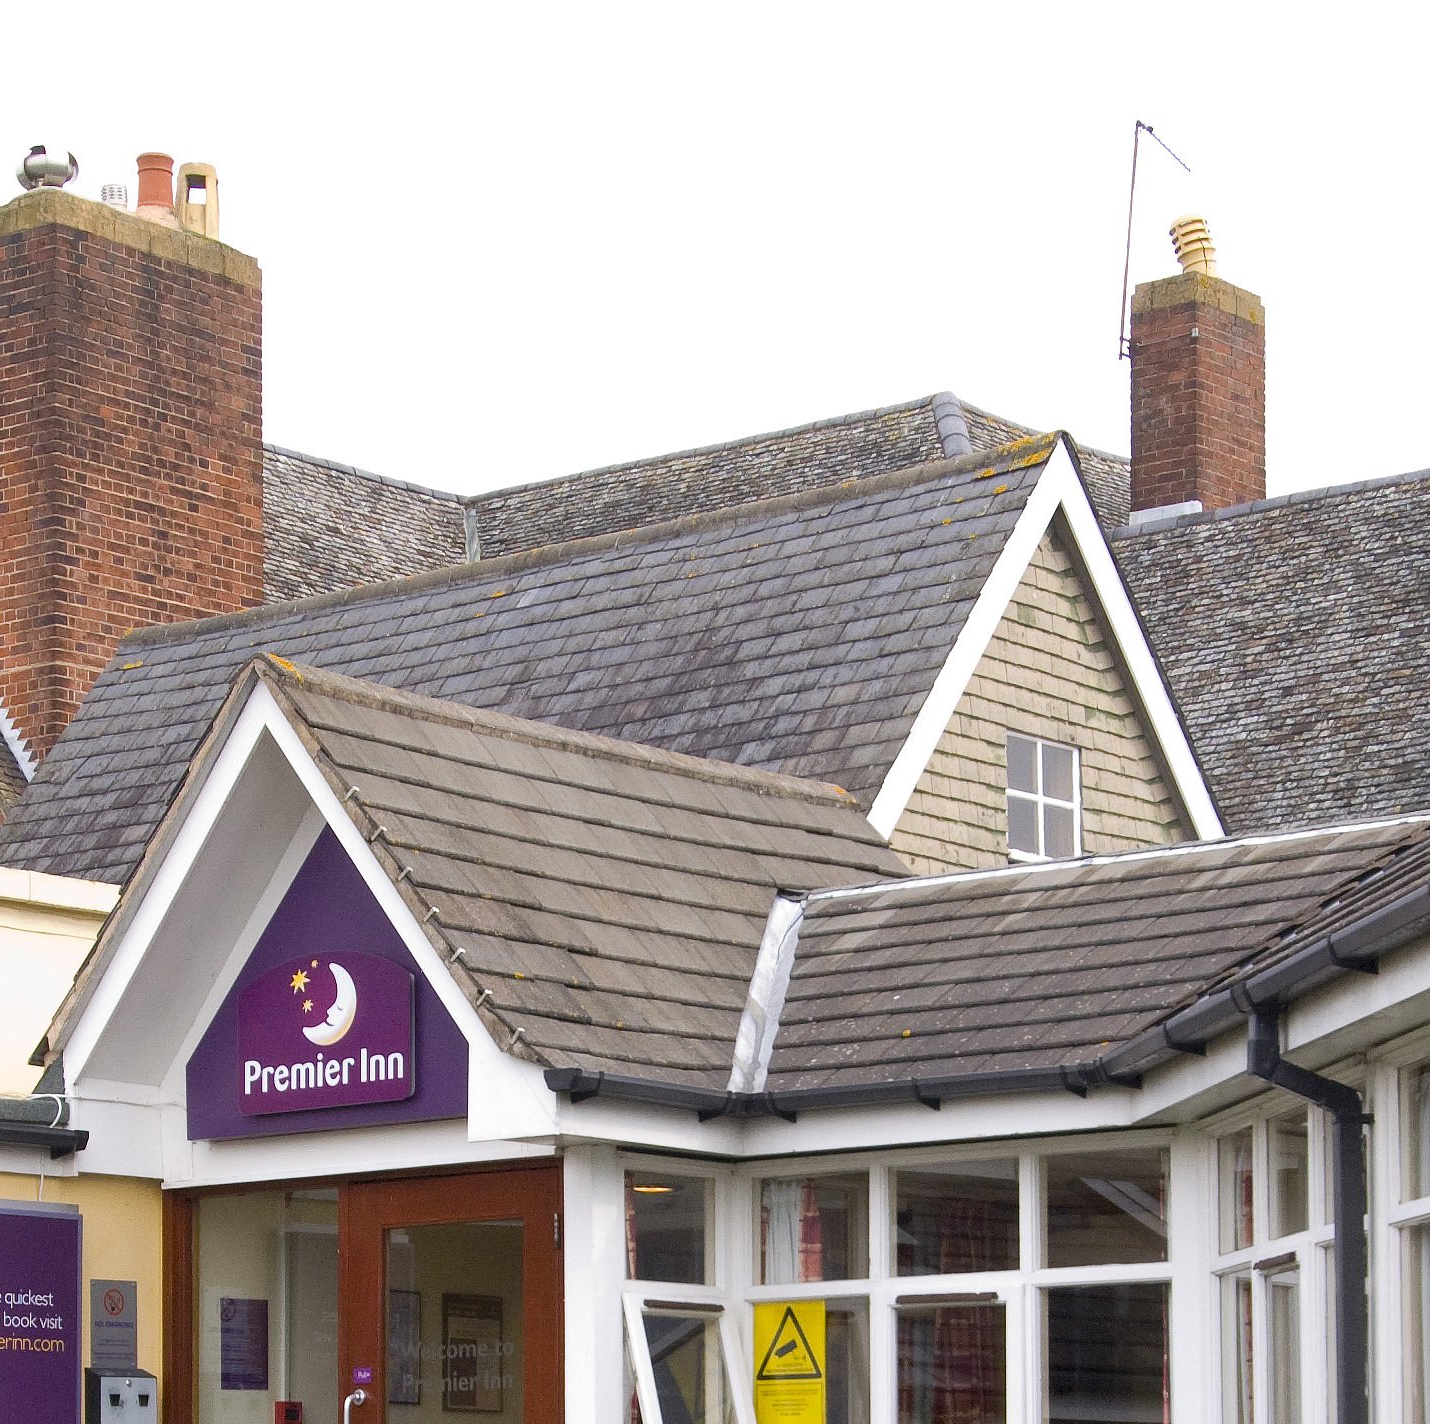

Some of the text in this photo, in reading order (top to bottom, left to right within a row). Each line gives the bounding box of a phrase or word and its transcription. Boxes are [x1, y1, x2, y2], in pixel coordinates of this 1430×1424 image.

[243, 1048, 404, 1095] Premier Inn
[4, 1288, 54, 1309] quickest
[3, 1311, 38, 1328] book
[39, 1312, 63, 1330] visit
[401, 1339, 514, 1360] Welcome to
[483, 1370, 514, 1390] Inn
